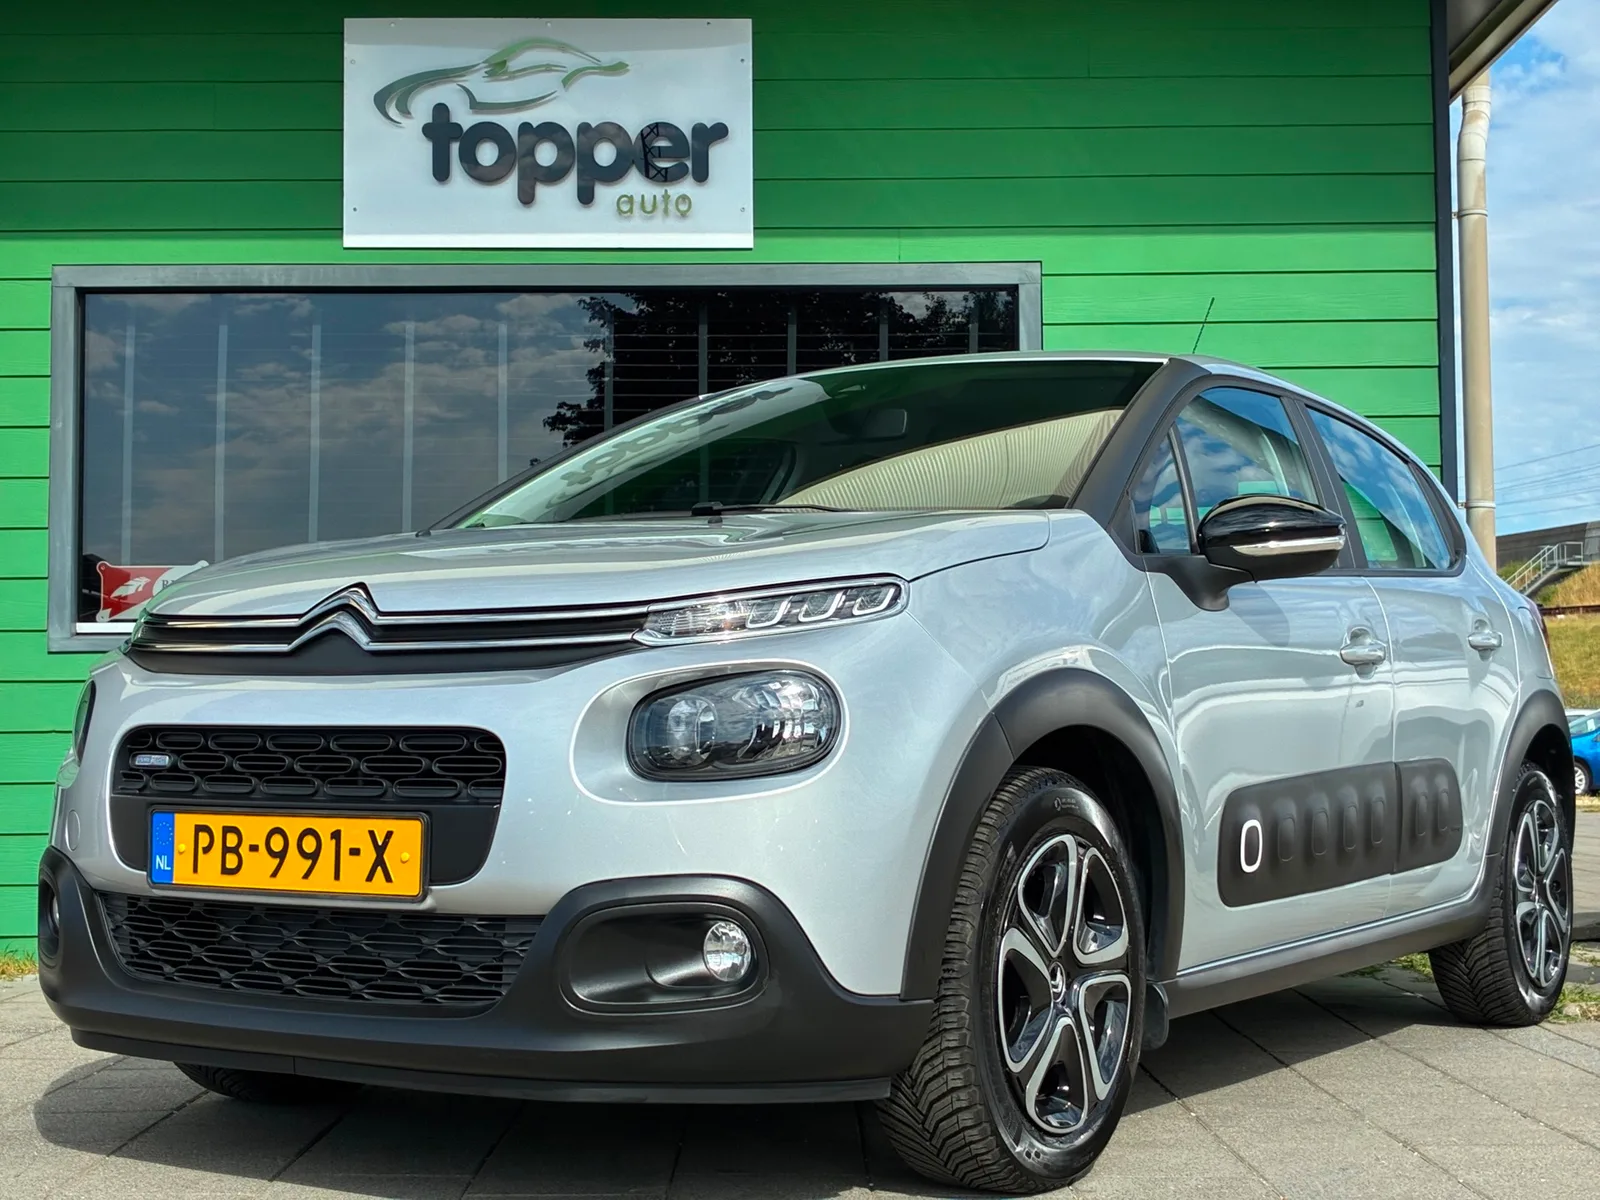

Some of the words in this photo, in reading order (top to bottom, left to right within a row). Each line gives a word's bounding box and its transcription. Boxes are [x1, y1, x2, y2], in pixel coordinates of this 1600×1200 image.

[422, 102, 729, 205] topper
[616, 189, 692, 216] auto
[155, 855, 171, 870] NL
[193, 823, 394, 883] PB-991-X
